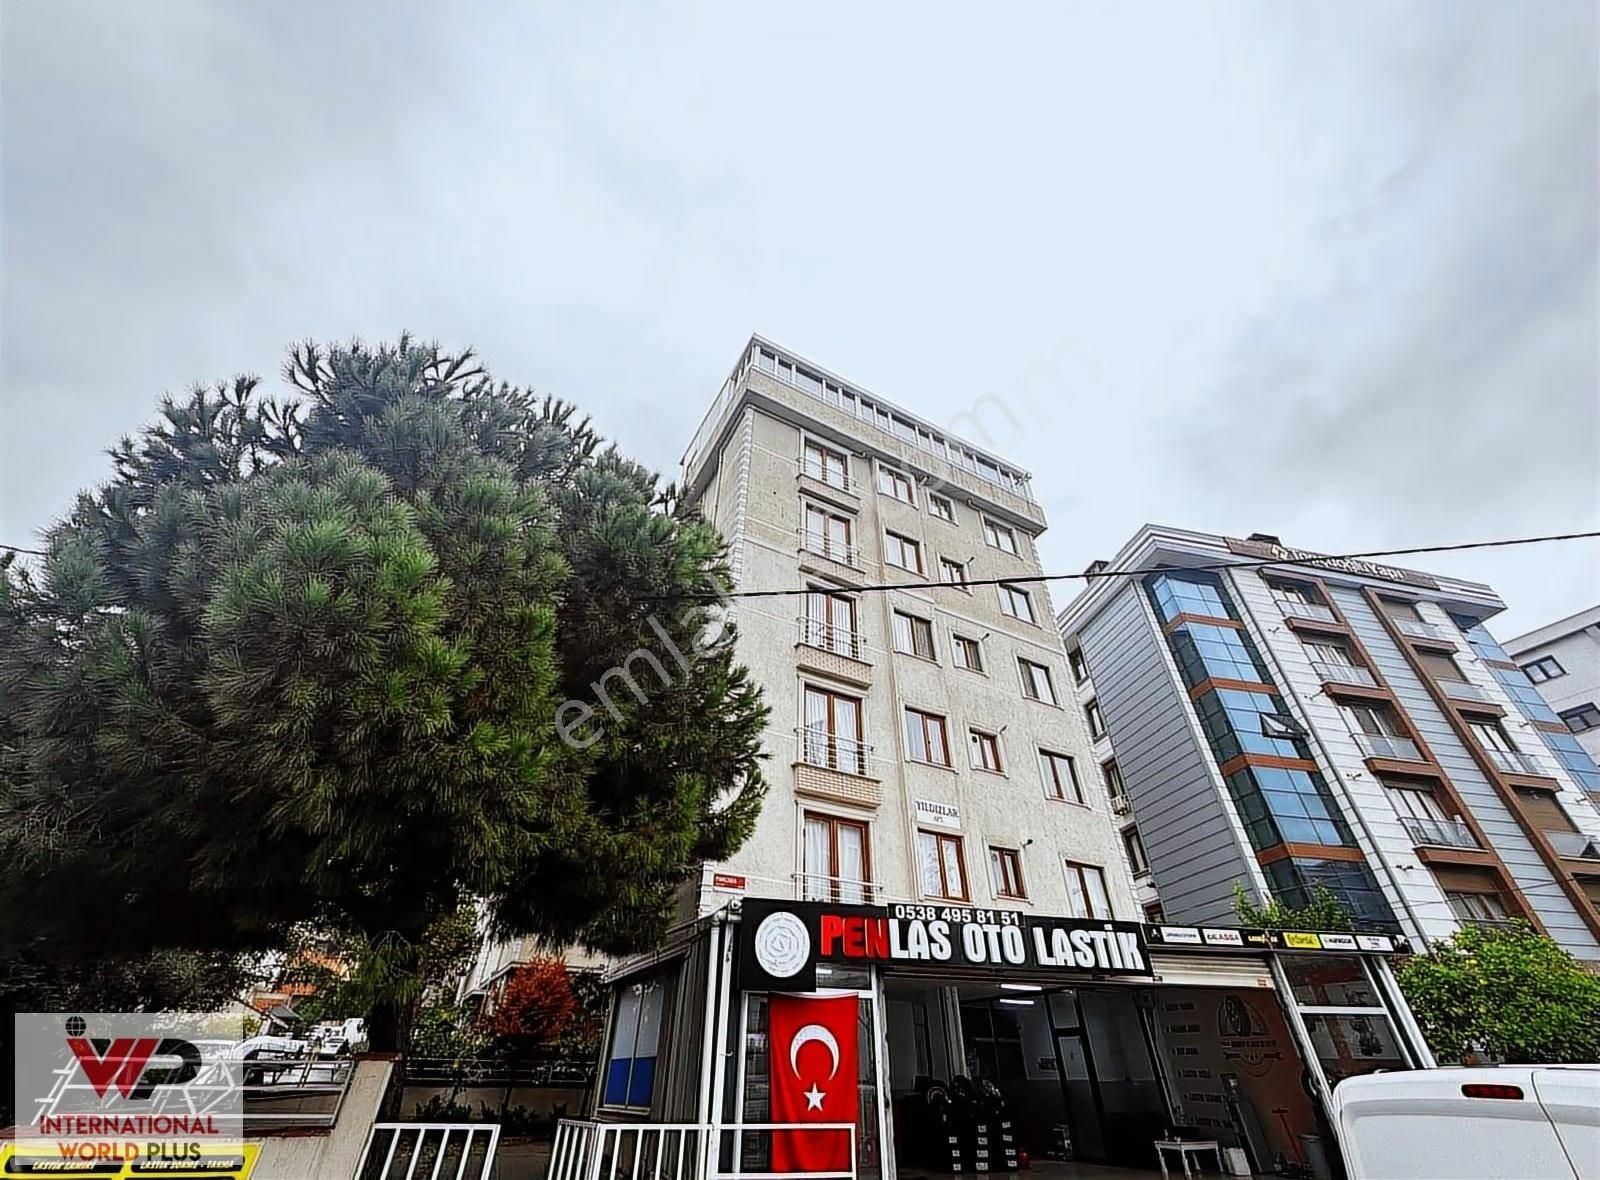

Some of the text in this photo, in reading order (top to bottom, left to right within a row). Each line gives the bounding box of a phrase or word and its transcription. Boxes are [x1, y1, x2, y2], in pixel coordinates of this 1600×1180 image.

[895, 905, 1019, 926] 0538 495 81 51
[820, 915, 1146, 970] PENLAS OTO LASTİK
